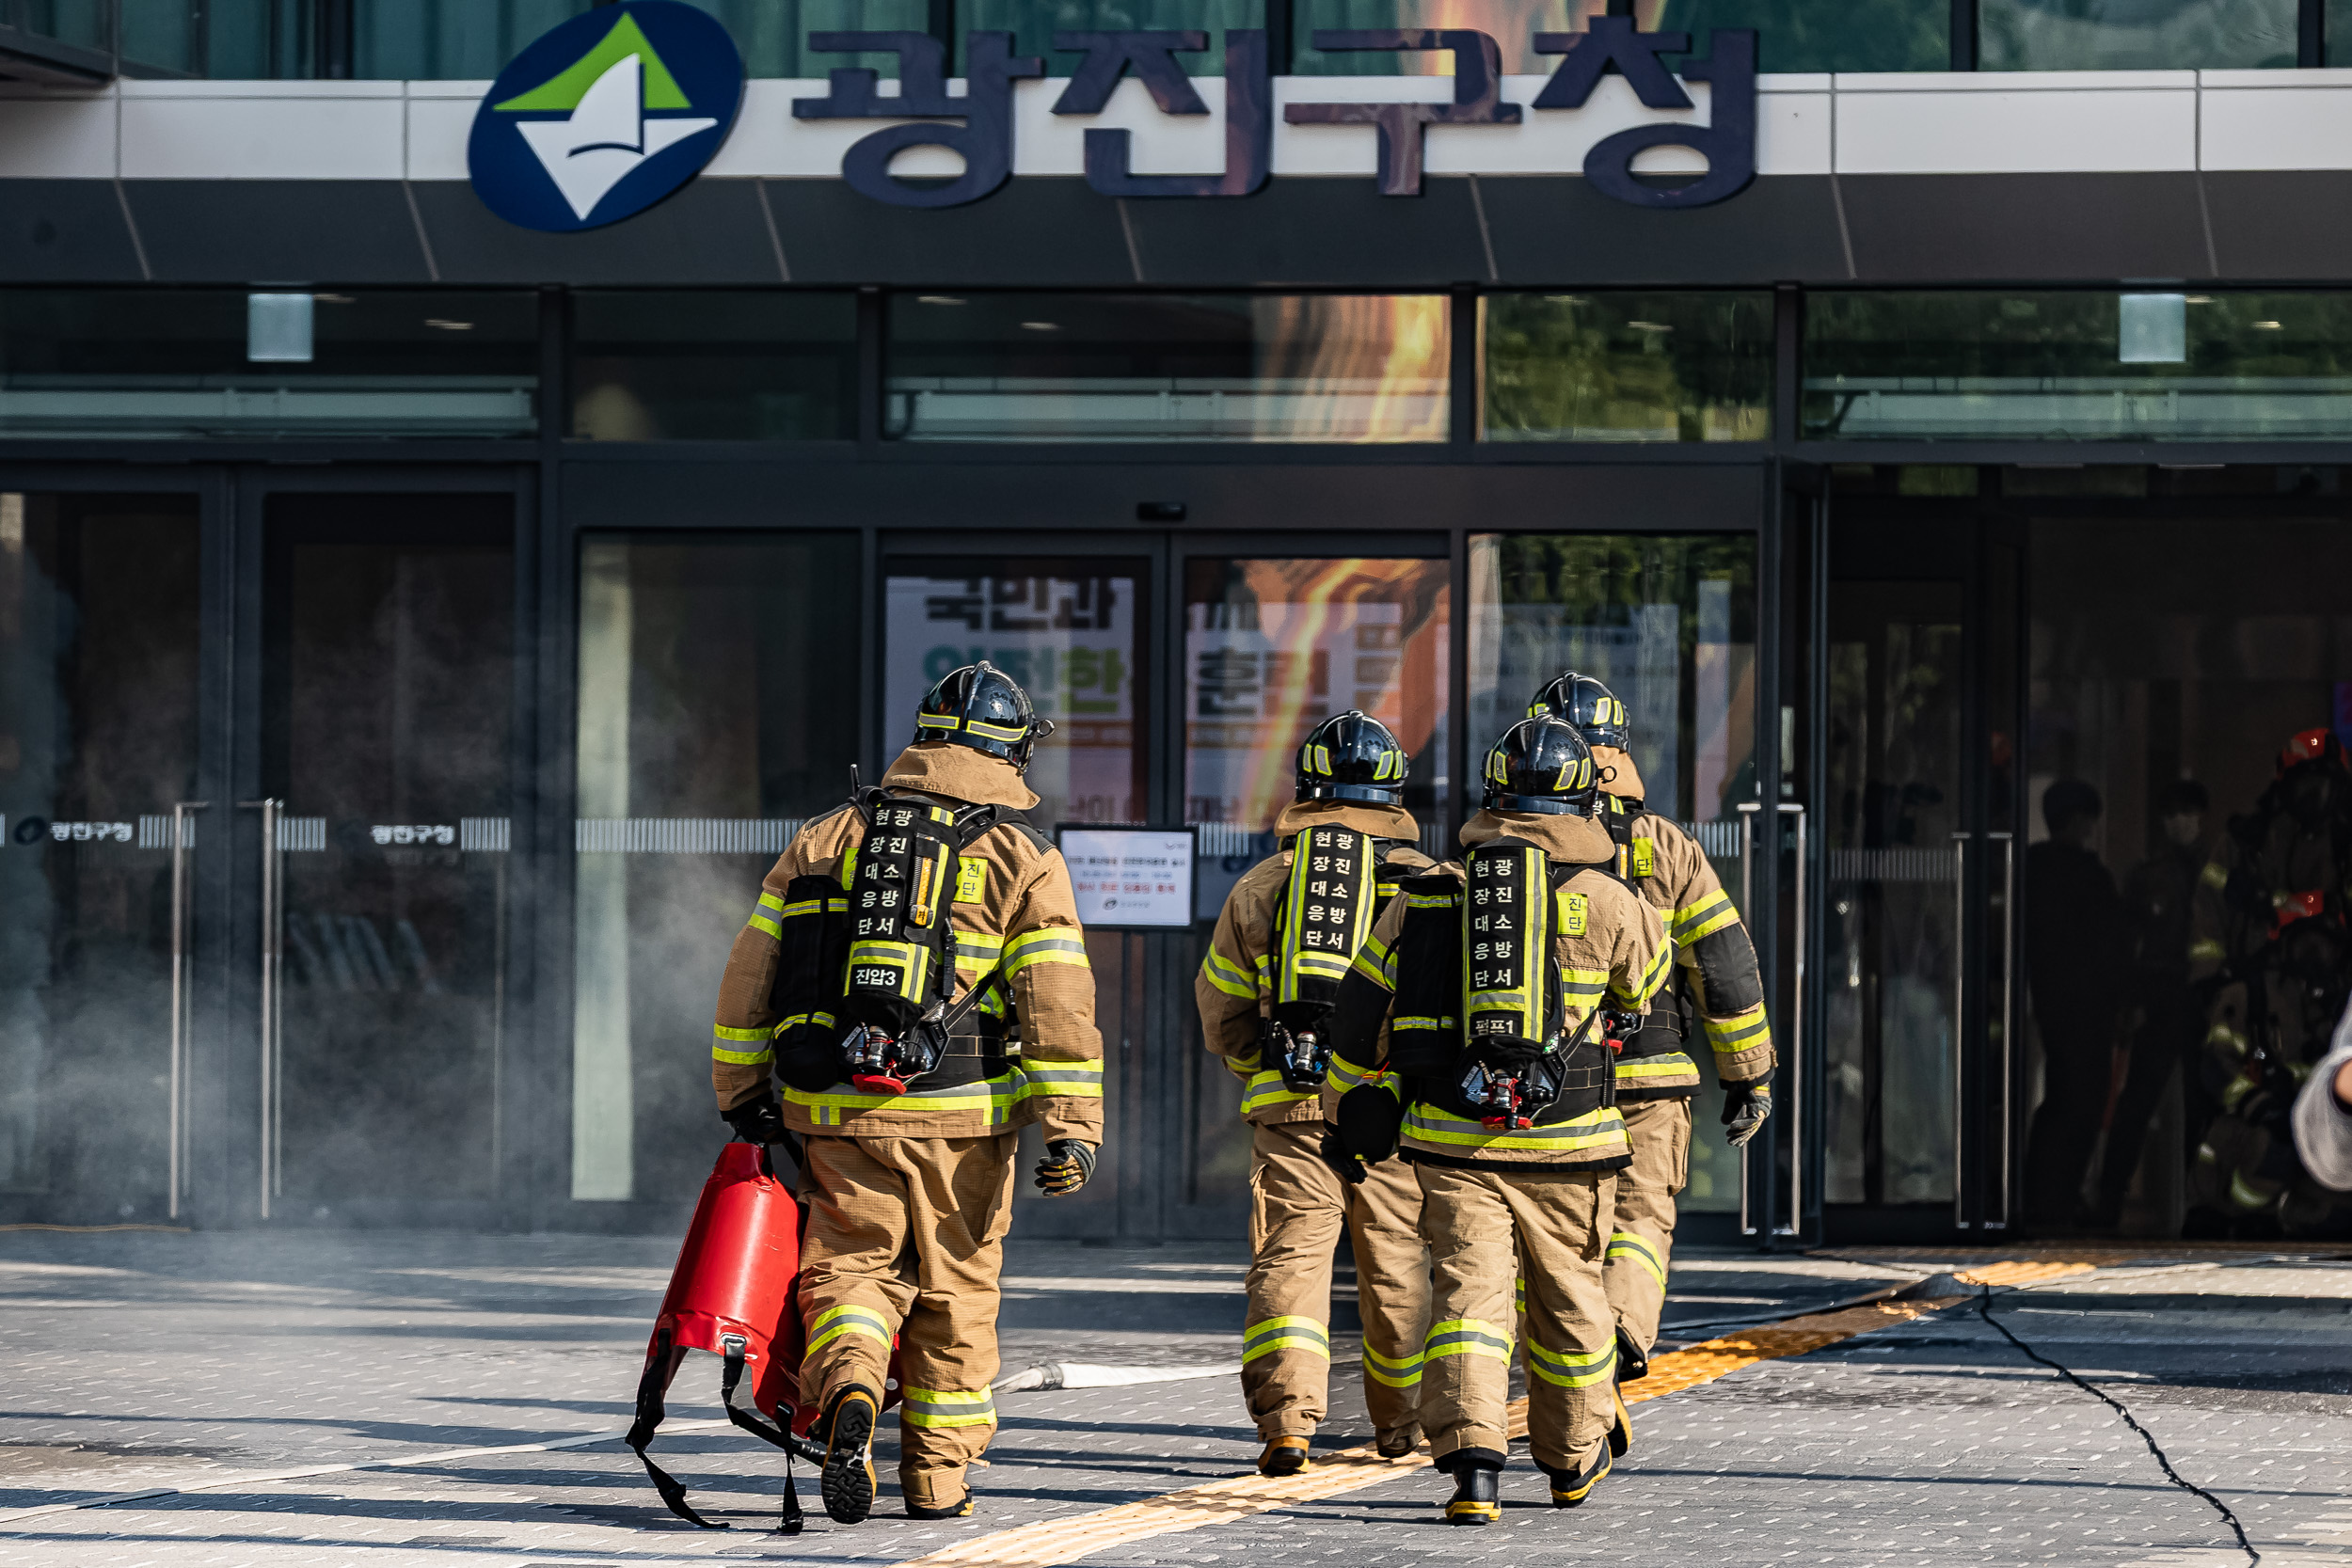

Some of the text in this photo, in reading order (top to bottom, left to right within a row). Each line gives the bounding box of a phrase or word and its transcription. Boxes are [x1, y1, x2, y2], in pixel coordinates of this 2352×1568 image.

[792, 15, 1758, 209] 광진구청
[857, 809, 889, 935] 현장대응단
[875, 809, 913, 936] 광진소방서
[1305, 832, 1331, 947] 현장대응단
[1326, 832, 1353, 950] 광진소방서
[1474, 861, 1489, 989] 현장대응단
[1494, 859, 1513, 988] 광진소방서
[855, 968, 897, 987] 진압3
[1475, 1019, 1515, 1035] 펌프1
